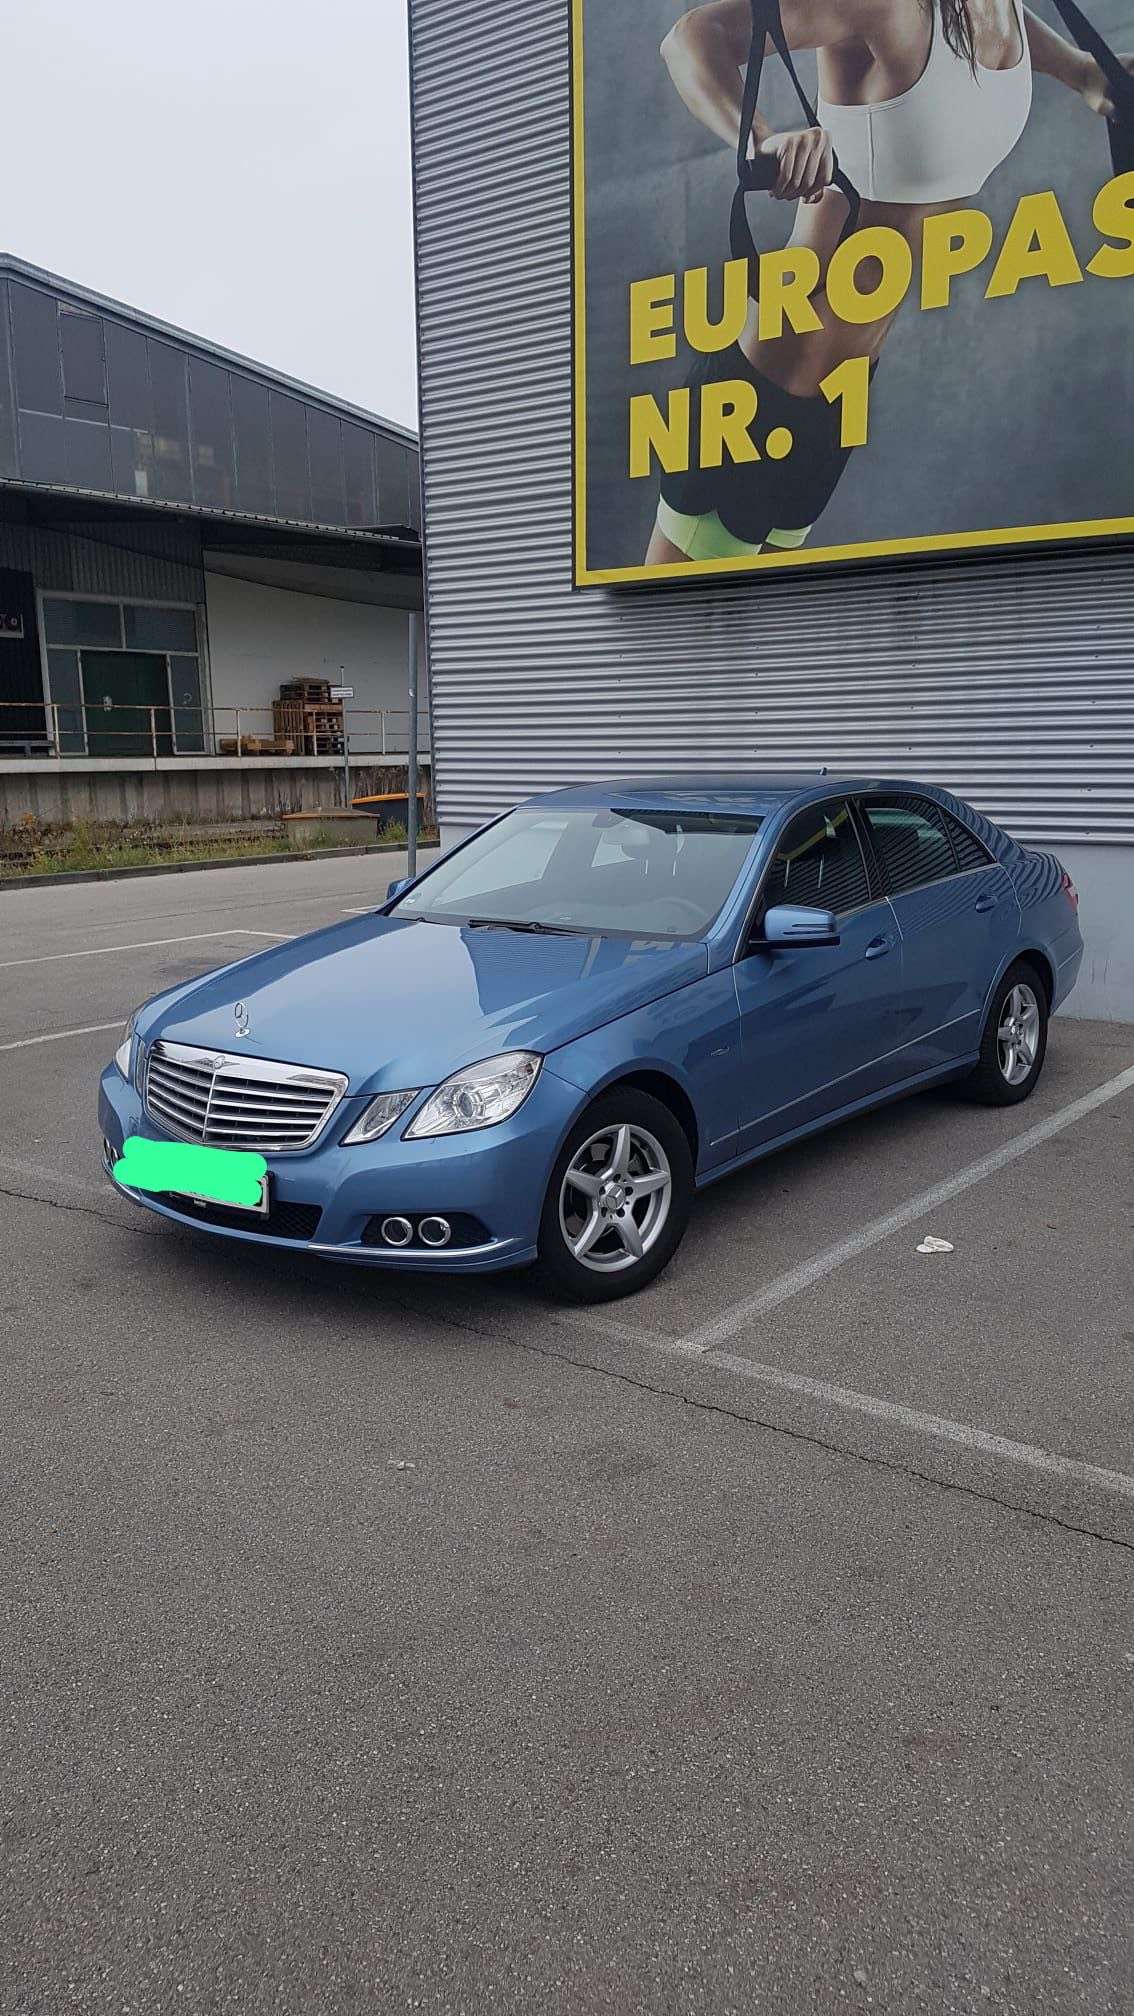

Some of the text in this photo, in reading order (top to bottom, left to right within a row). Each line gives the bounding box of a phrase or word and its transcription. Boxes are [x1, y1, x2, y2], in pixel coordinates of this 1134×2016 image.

[630, 171, 1134, 365] EUROPAS
[629, 356, 870, 478] NR. 1
